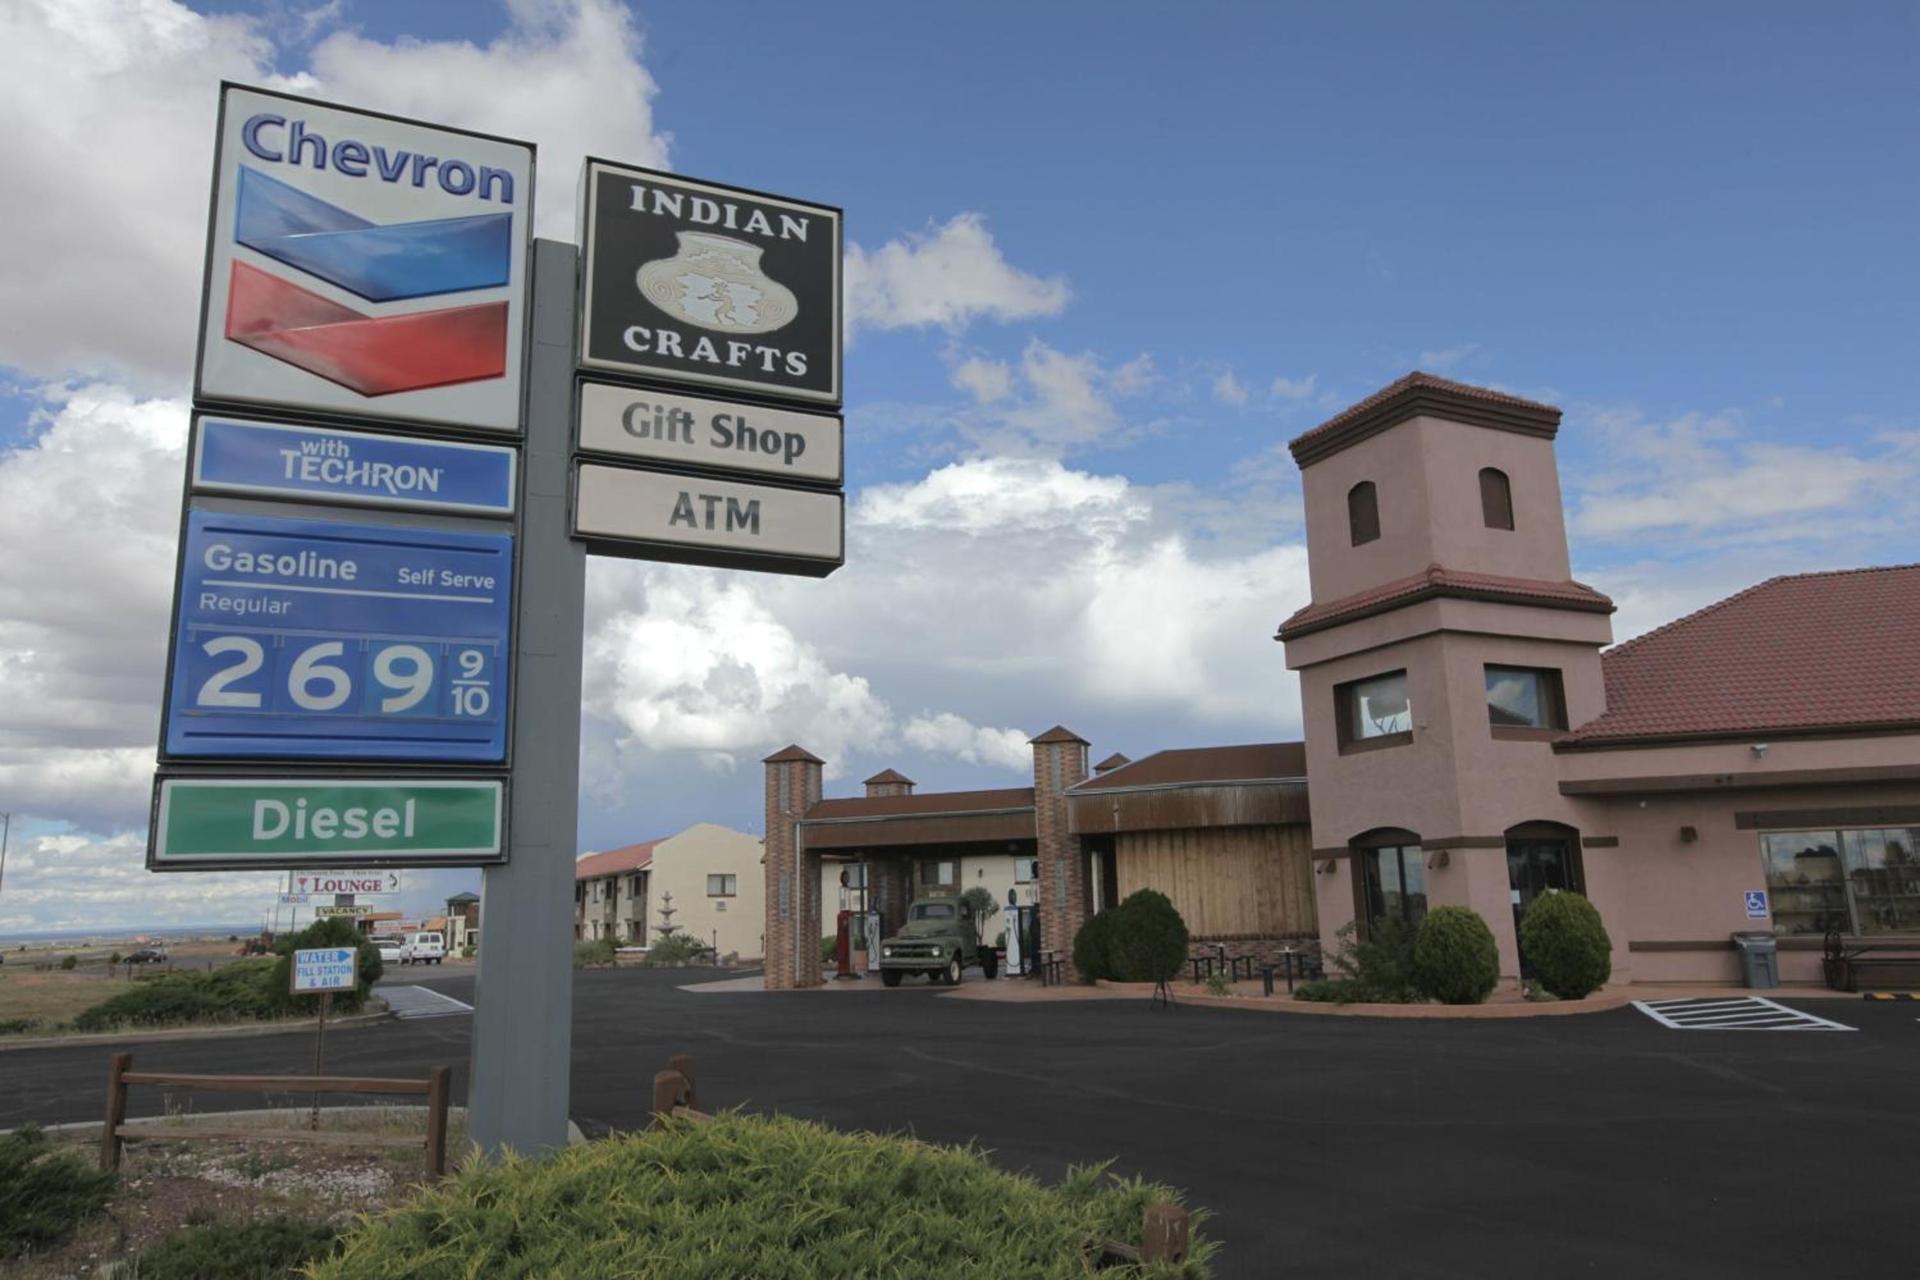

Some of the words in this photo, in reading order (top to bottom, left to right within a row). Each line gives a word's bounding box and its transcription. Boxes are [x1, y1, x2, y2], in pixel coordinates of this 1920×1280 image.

[241, 113, 514, 204] Chevron
[629, 184, 809, 243] INDIAN
[623, 325, 809, 377] CRAFTS
[301, 438, 350, 458] with
[621, 402, 695, 445] Gift
[710, 413, 806, 465] Shop
[280, 449, 440, 494] TECHRON
[668, 491, 760, 535] ATM
[204, 544, 357, 580] Gasoline
[397, 567, 434, 586] Self
[440, 570, 496, 590] Serve
[200, 593, 292, 616] Regular
[252, 797, 416, 840] Diesel
[313, 878, 383, 892] LOUNGE
[321, 906, 369, 915] VACANCY
[297, 966, 316, 977] FILL
[318, 964, 353, 976] STATION
[298, 951, 338, 964] WATER
[321, 976, 342, 987] AIR
